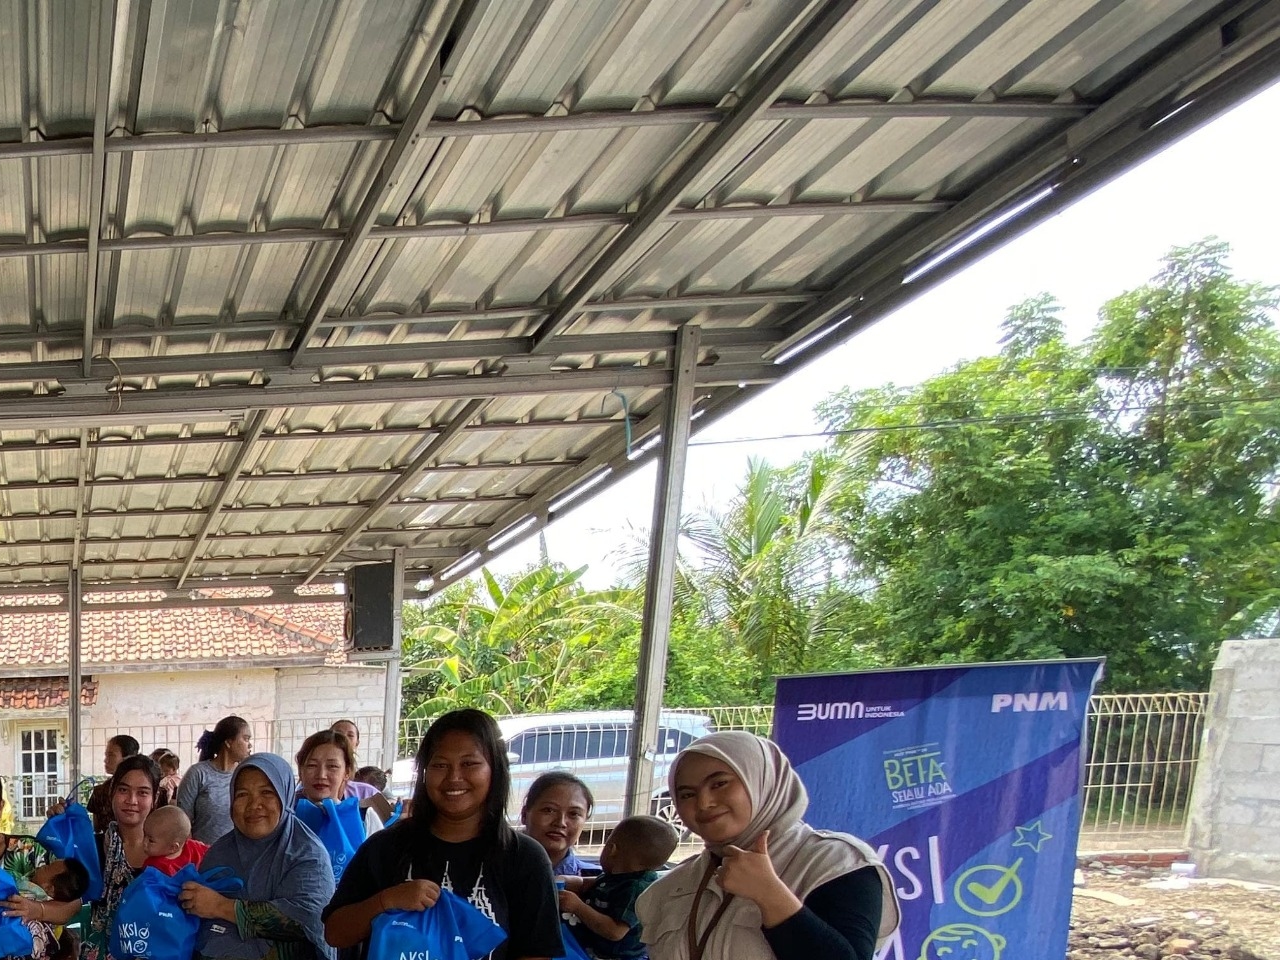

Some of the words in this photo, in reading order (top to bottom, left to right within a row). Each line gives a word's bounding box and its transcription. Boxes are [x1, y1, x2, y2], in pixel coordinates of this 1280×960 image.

[991, 692, 1068, 713] PNM
[864, 711, 905, 719] INDONESIA
[883, 751, 947, 790] BETA
[892, 786, 925, 803] SELALU
[927, 781, 953, 797] ADA
[877, 835, 945, 904] SI
